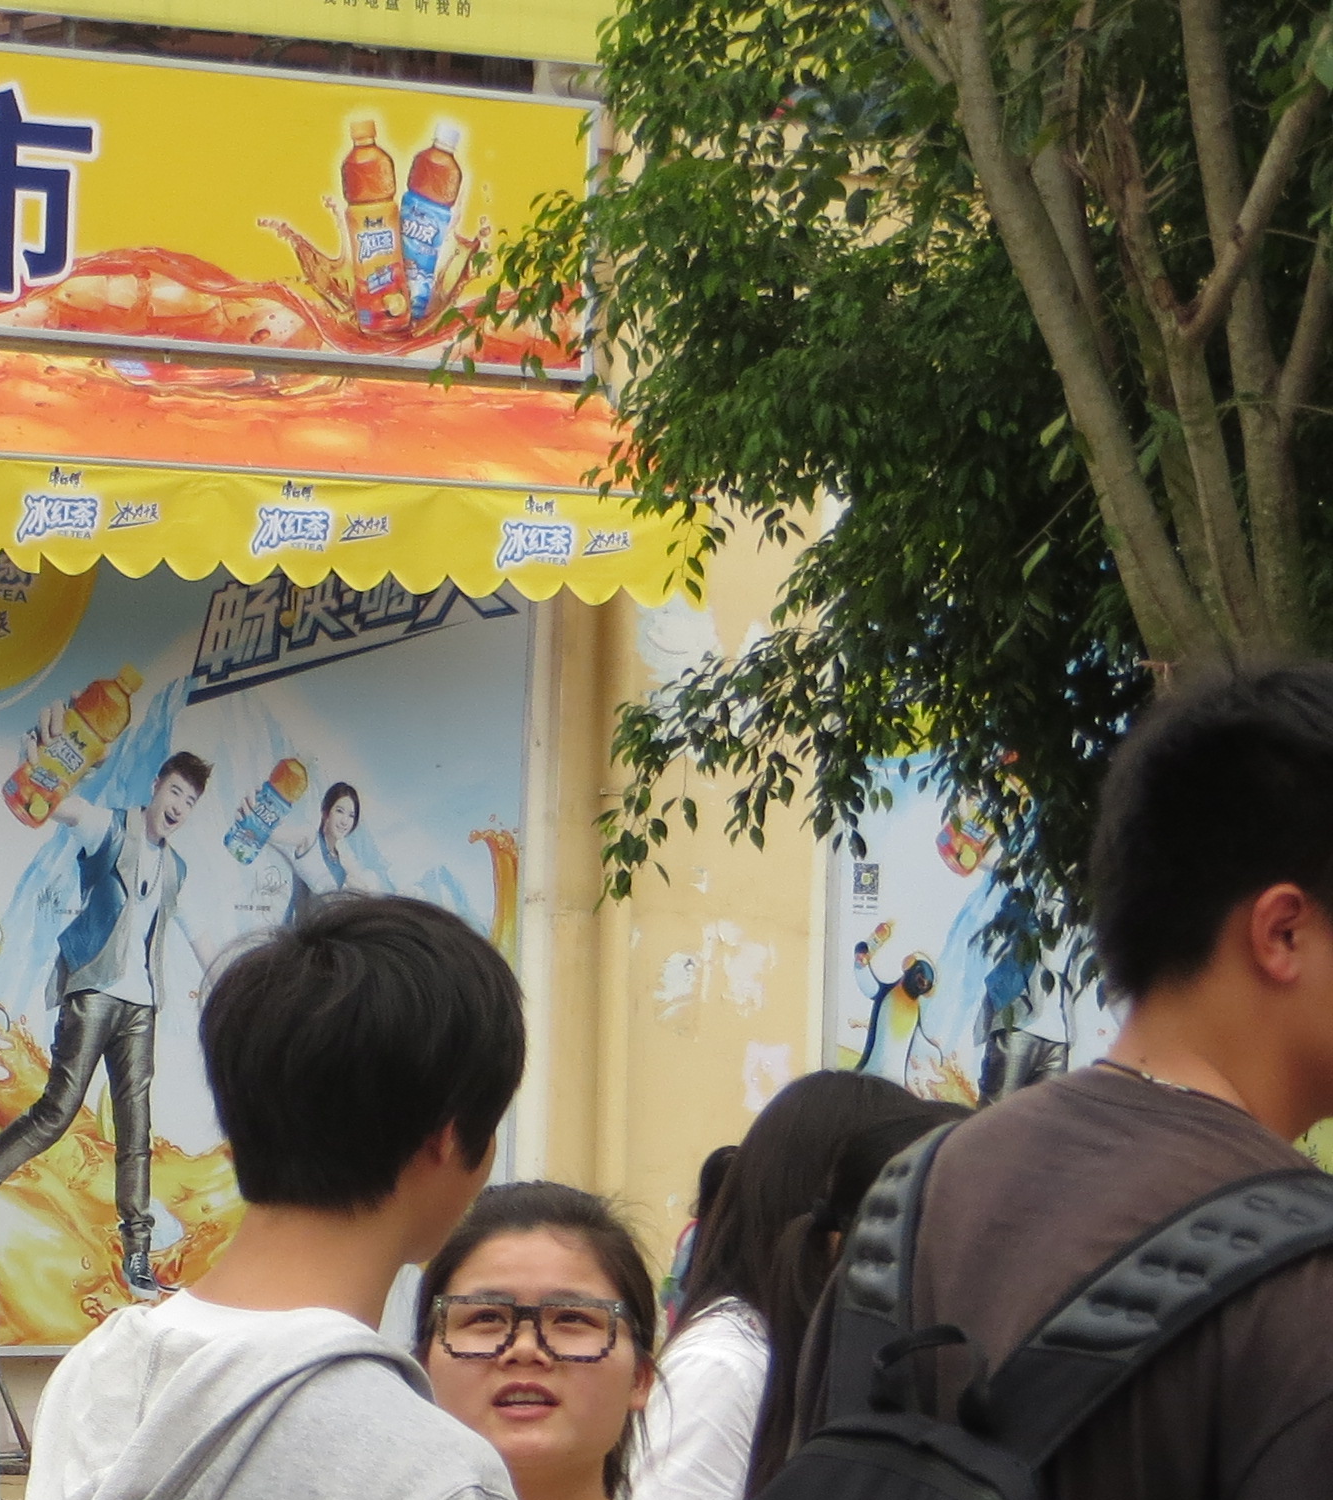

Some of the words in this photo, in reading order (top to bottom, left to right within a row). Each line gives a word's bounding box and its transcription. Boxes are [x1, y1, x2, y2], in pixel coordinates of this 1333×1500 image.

[16, 495, 97, 542] 冰红茶
[252, 507, 331, 554] 冰红茶
[496, 520, 574, 567] 冰红茶
